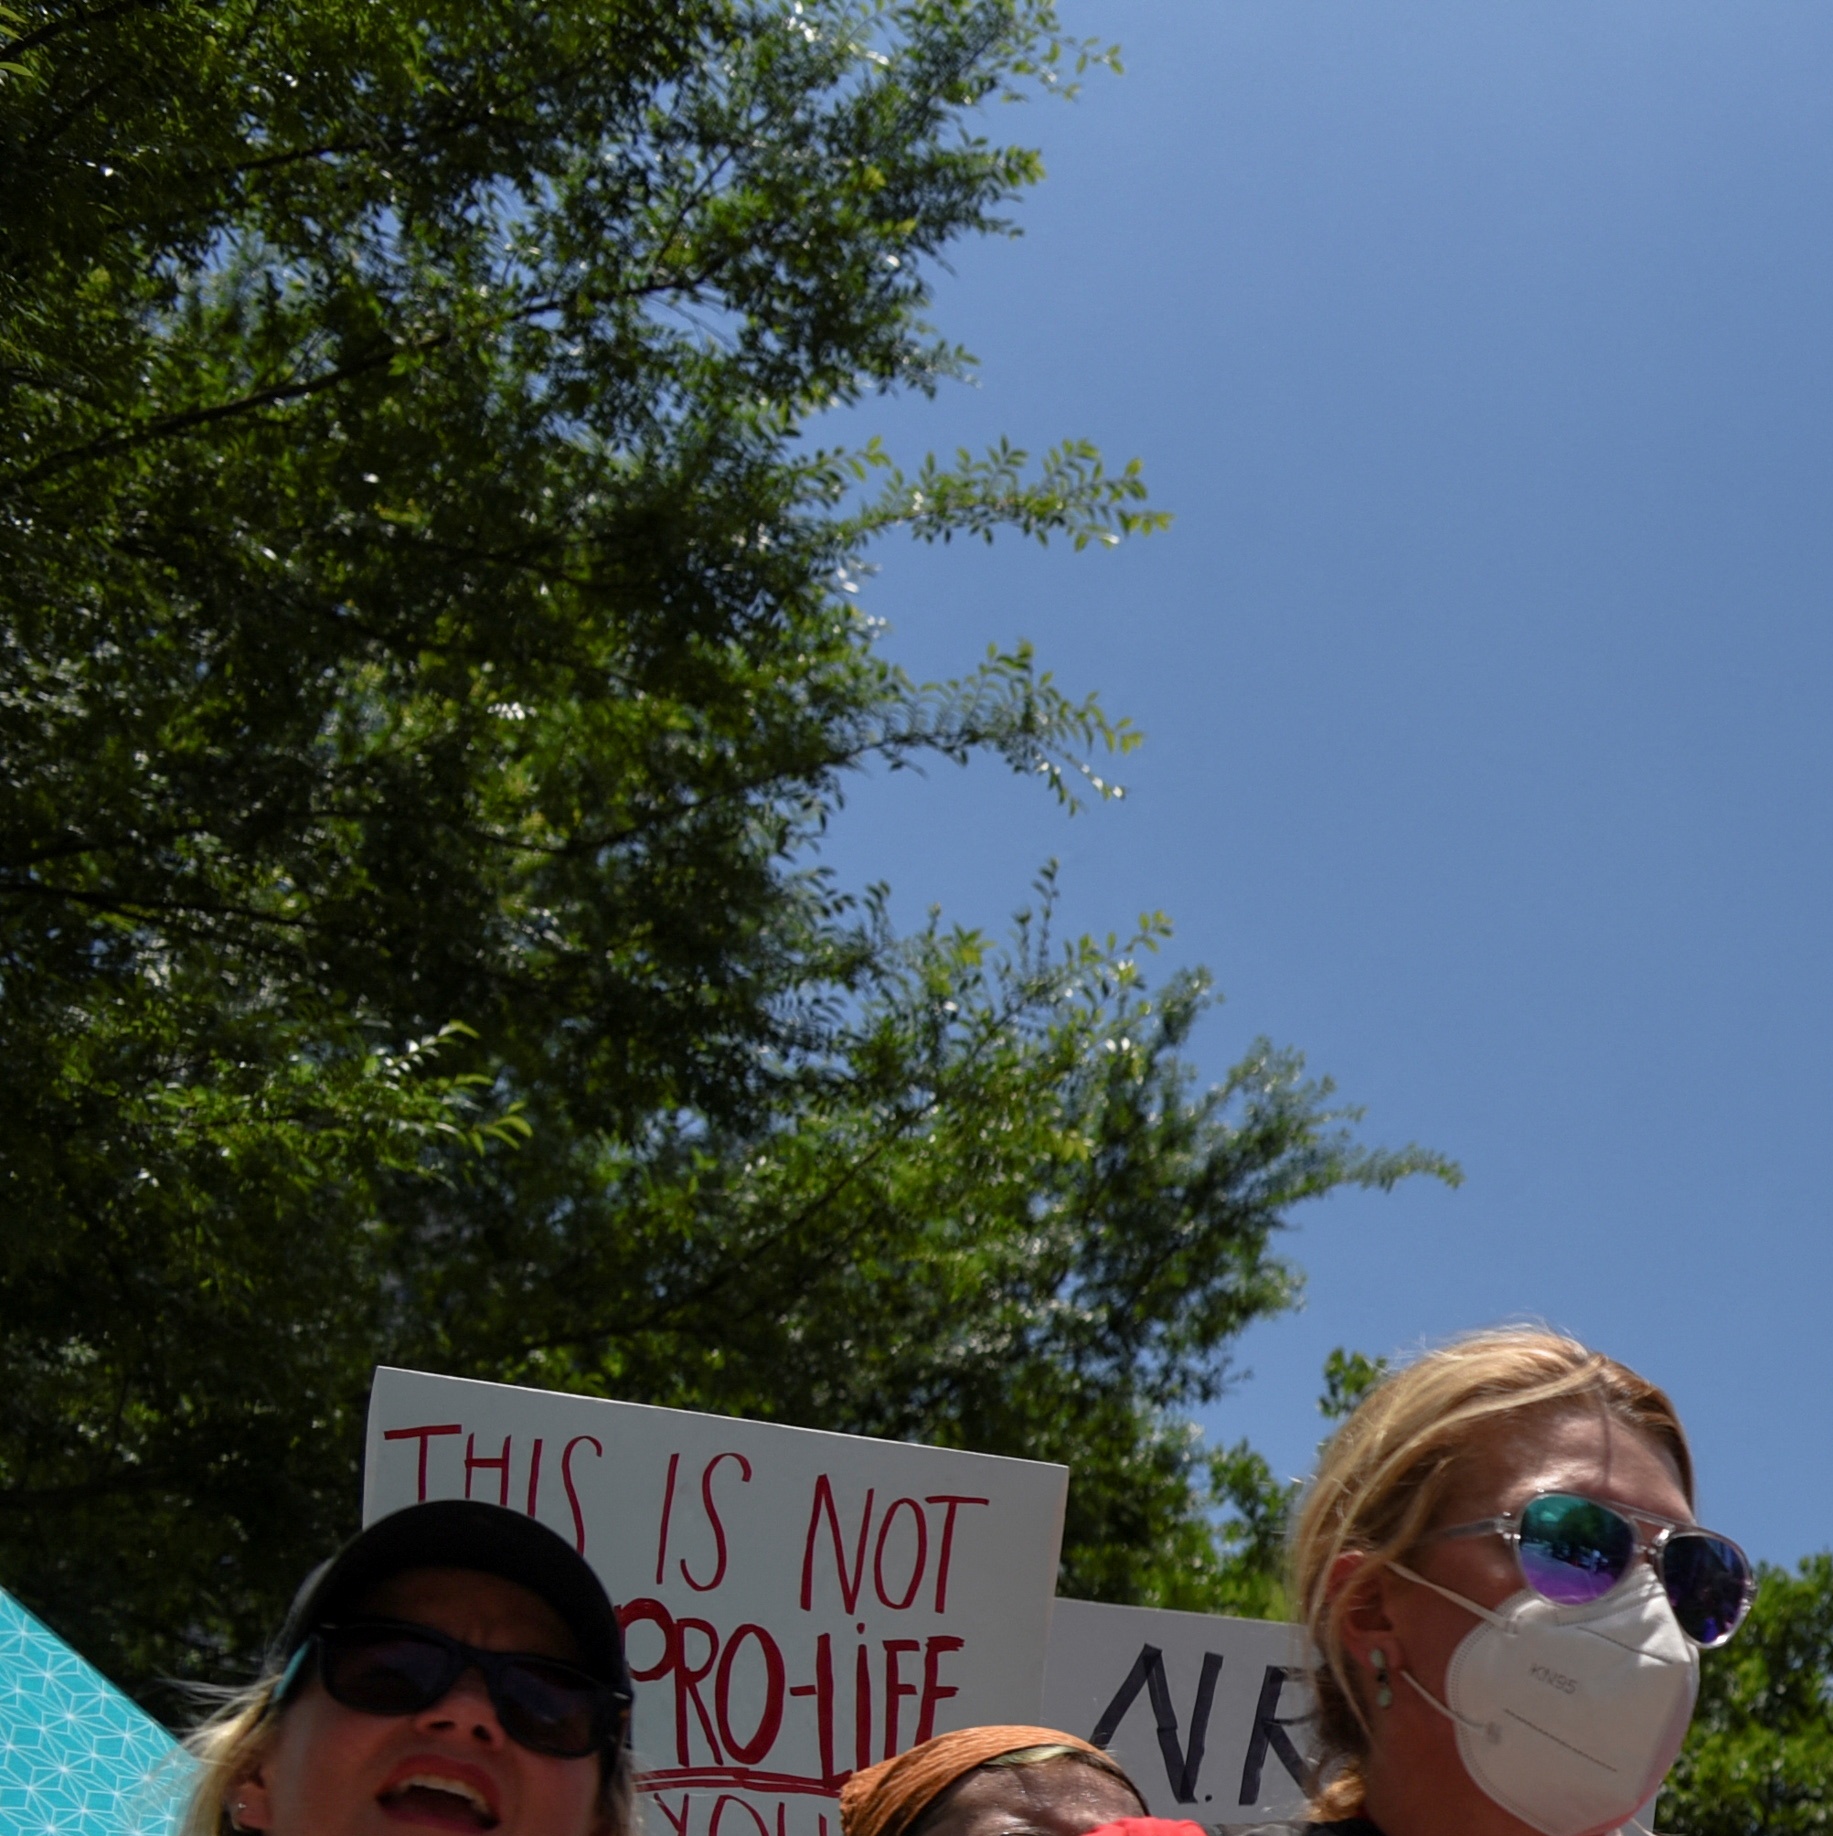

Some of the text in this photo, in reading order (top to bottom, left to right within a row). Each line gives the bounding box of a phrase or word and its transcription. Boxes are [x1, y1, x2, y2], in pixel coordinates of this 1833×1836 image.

[384, 1424, 990, 1614] THIS IS NOT
[1528, 1662, 1578, 1695] KN95
